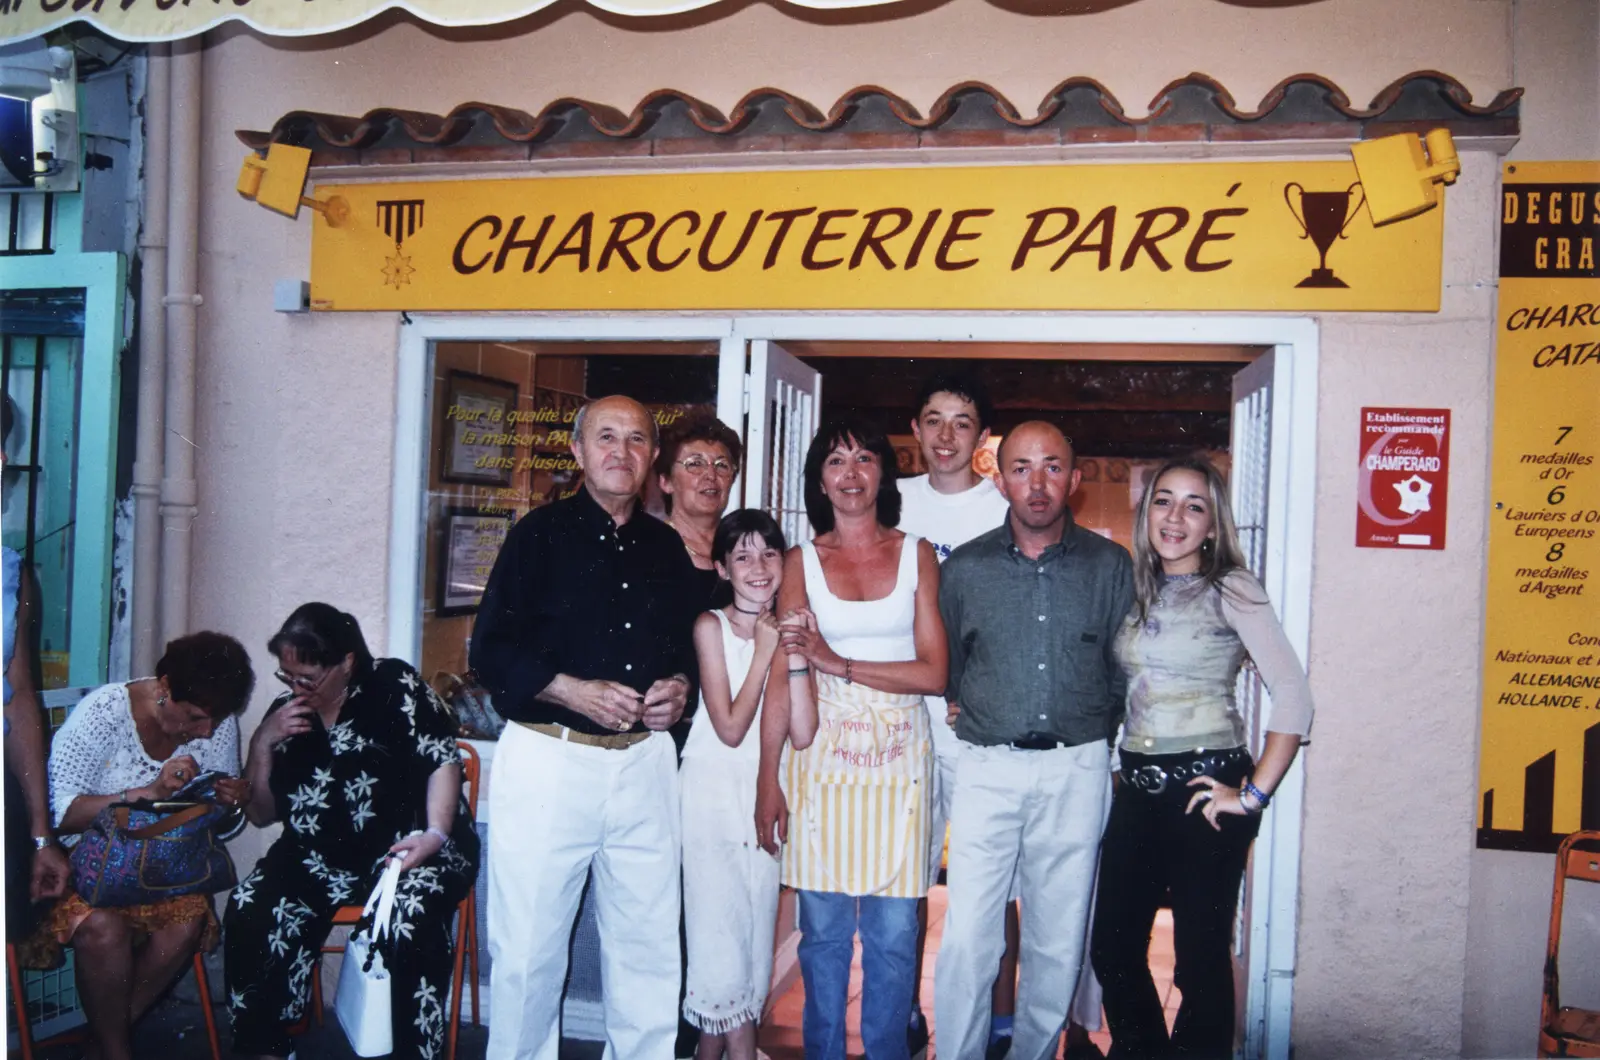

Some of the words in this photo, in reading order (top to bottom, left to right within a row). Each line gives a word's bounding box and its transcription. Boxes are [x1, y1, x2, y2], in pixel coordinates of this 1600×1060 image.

[453, 205, 995, 275] CHARCUTERIE
[1011, 183, 1248, 273] PARÉ
[1535, 236, 1595, 270] GRA
[446, 404, 486, 421] Pour
[487, 406, 503, 423] la
[1366, 411, 1445, 425] Etablissement
[462, 428, 477, 445] la
[481, 430, 543, 446] maison
[545, 429, 574, 446] PA
[1366, 423, 1445, 435] recommandé
[1553, 425, 1574, 447] 7
[1384, 445, 1393, 455] le
[1394, 445, 1425, 456] Guide
[474, 452, 517, 470] dans
[1366, 454, 1441, 472] CHAMPERARD
[1546, 484, 1567, 506] 6
[1504, 507, 1567, 522] Lauriers
[1514, 523, 1596, 541] Europeens
[1545, 541, 1566, 562] 8
[1495, 649, 1574, 665] Nationaux
[1576, 653, 1594, 667] et
[1508, 671, 1600, 690] ALLEMAGNE
